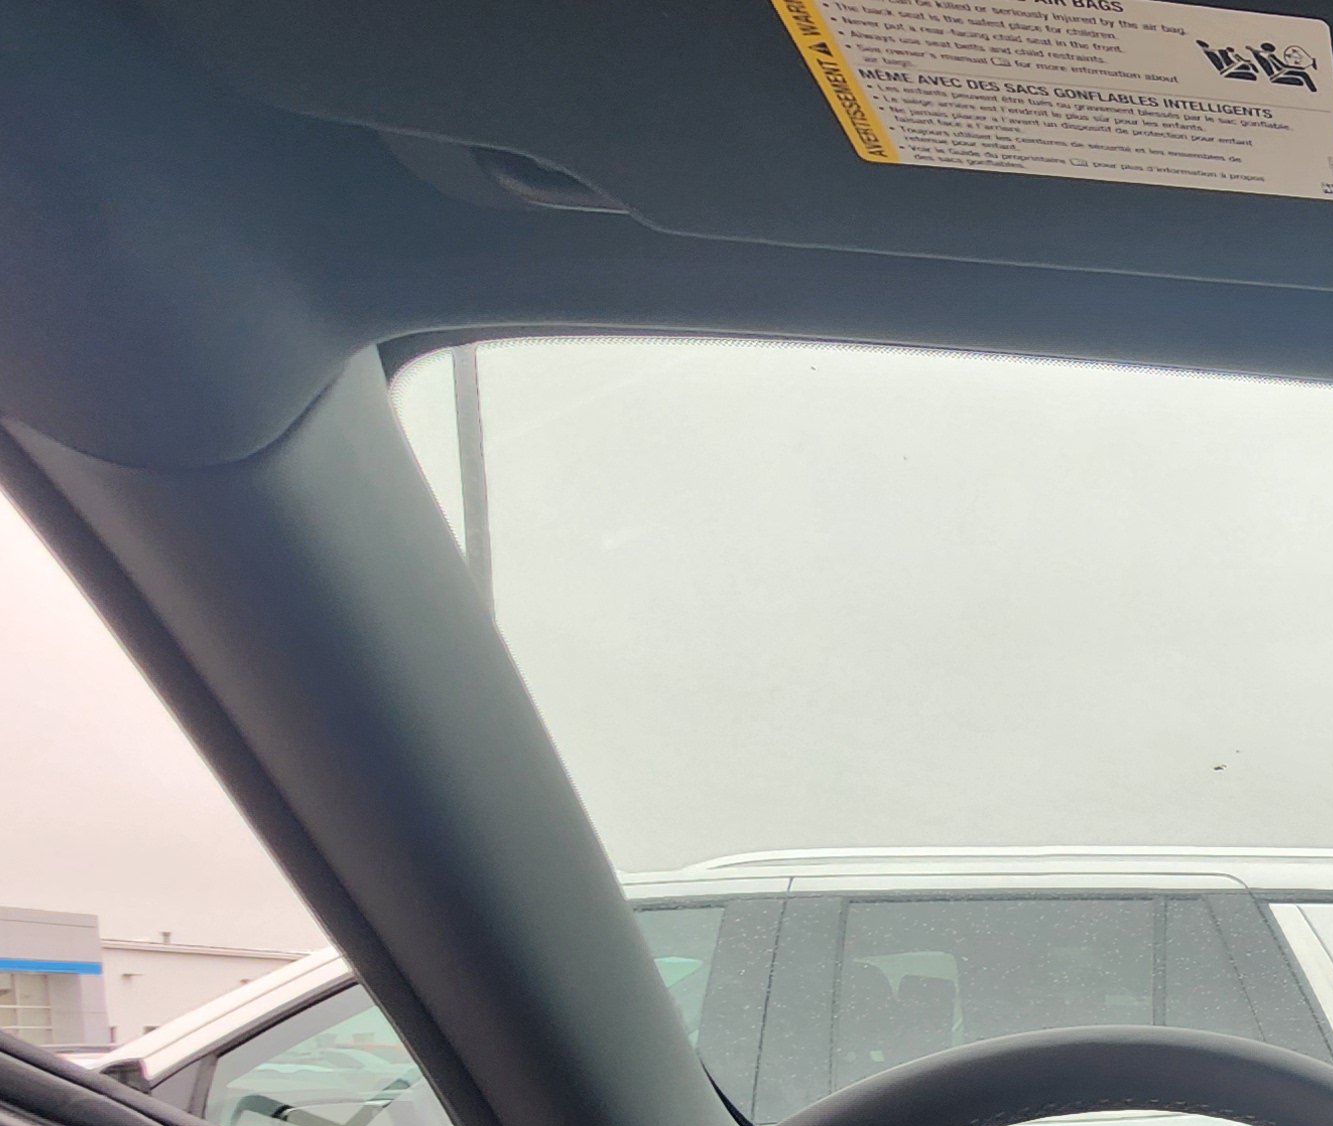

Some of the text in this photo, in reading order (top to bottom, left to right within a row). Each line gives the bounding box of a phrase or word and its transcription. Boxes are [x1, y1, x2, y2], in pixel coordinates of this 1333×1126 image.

[918, 75, 963, 89] AVEC
[966, 79, 1000, 92] DES
[1004, 83, 1049, 97] SACS
[1053, 88, 1159, 107] GONFLABLES
[1163, 98, 1273, 119] INTELLIGENTS
